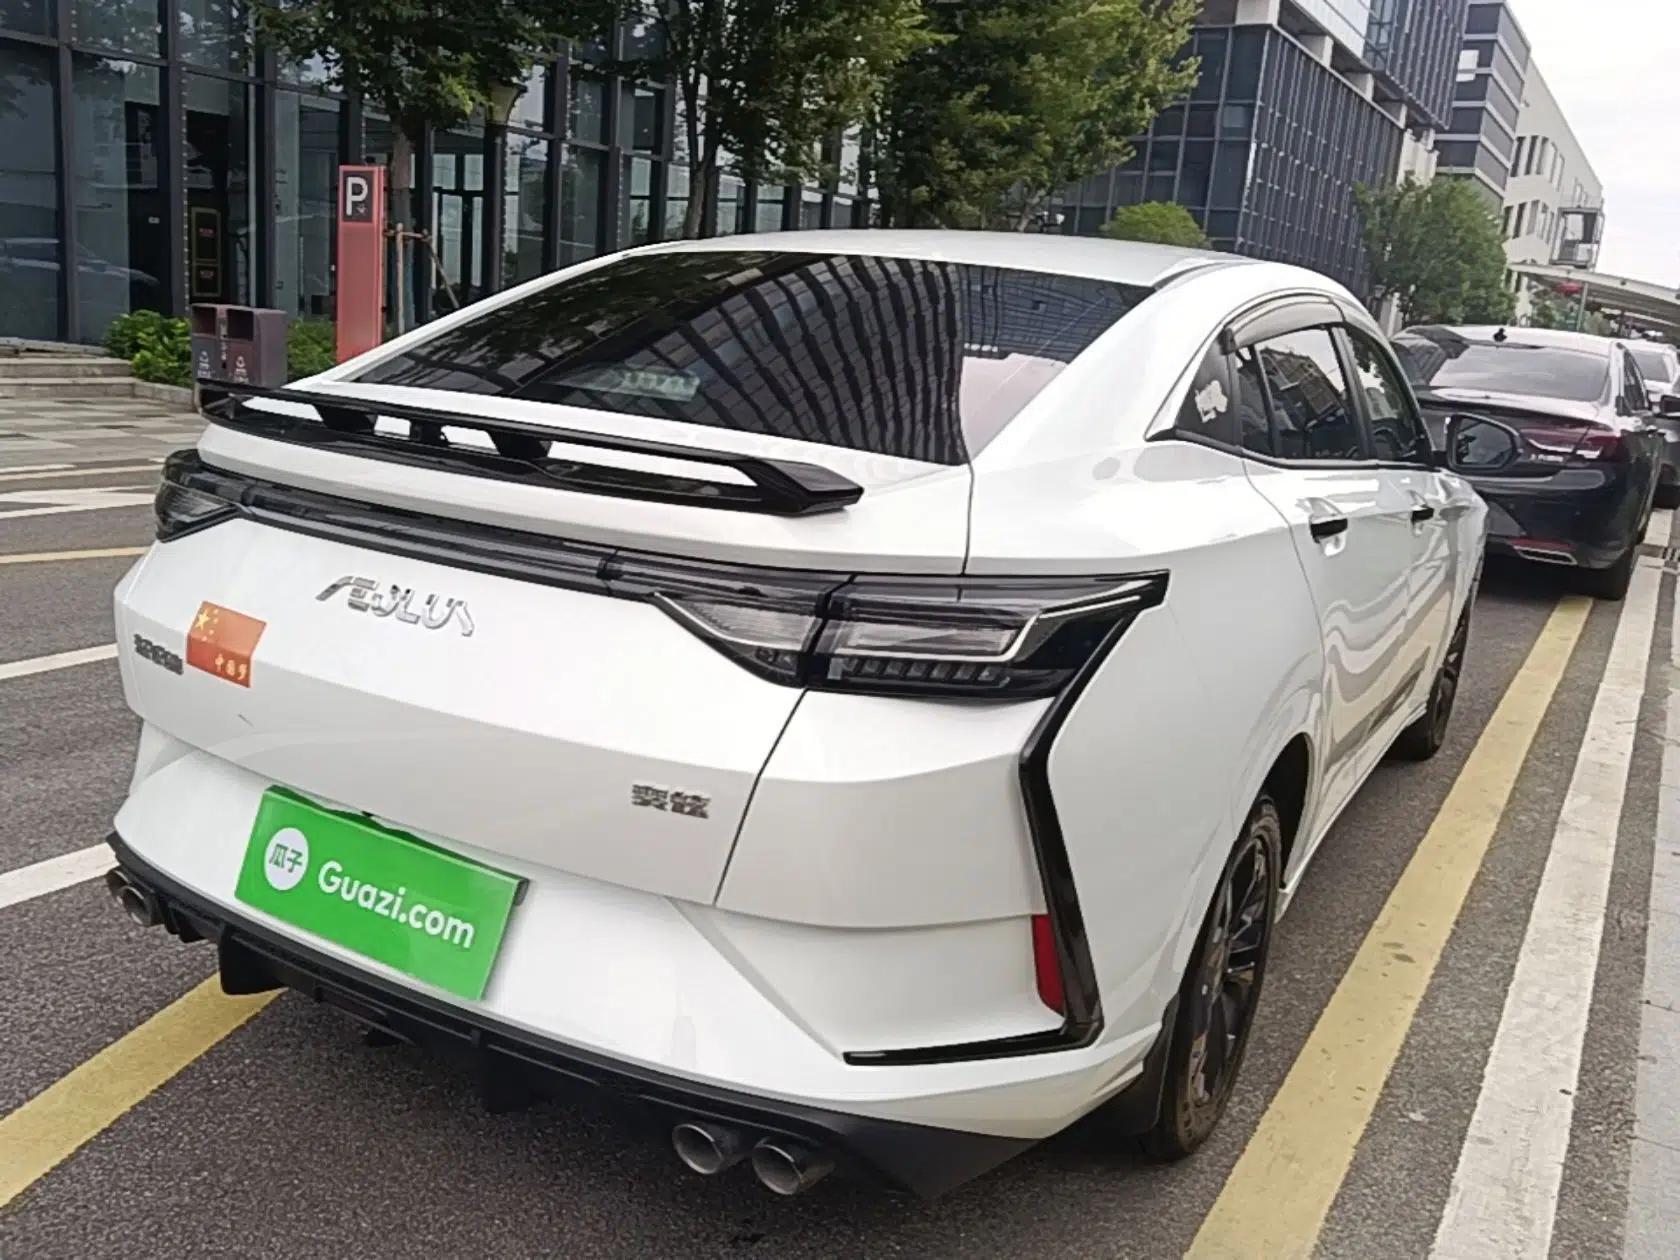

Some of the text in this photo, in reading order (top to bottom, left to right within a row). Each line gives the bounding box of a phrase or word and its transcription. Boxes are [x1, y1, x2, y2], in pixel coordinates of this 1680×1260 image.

[346, 176, 368, 216] P
[268, 843, 303, 873] 瓜子
[318, 860, 475, 948] Guazi.com
